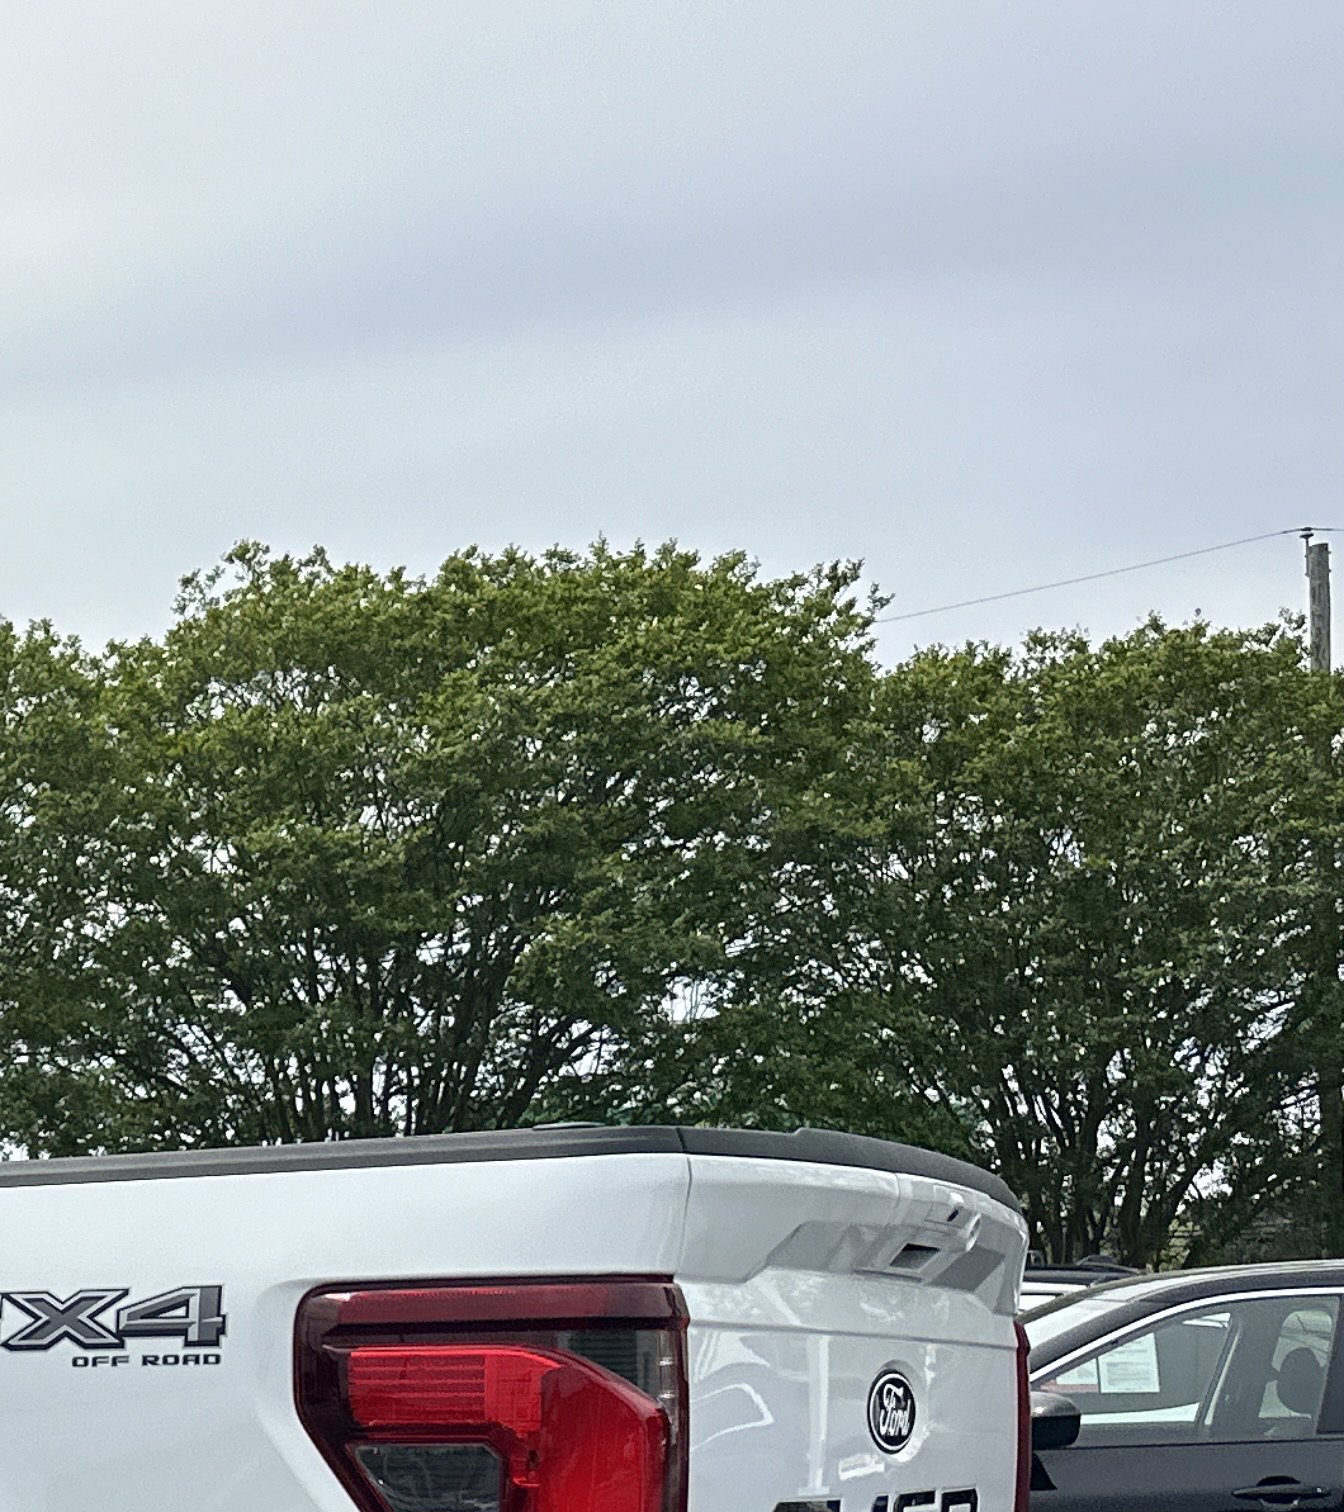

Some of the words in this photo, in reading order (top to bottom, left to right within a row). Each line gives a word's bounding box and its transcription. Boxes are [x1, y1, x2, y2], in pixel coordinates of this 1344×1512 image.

[71, 1355, 130, 1368] OFF
[141, 1353, 222, 1367] ROAD
[879, 1383, 912, 1436] Ford
